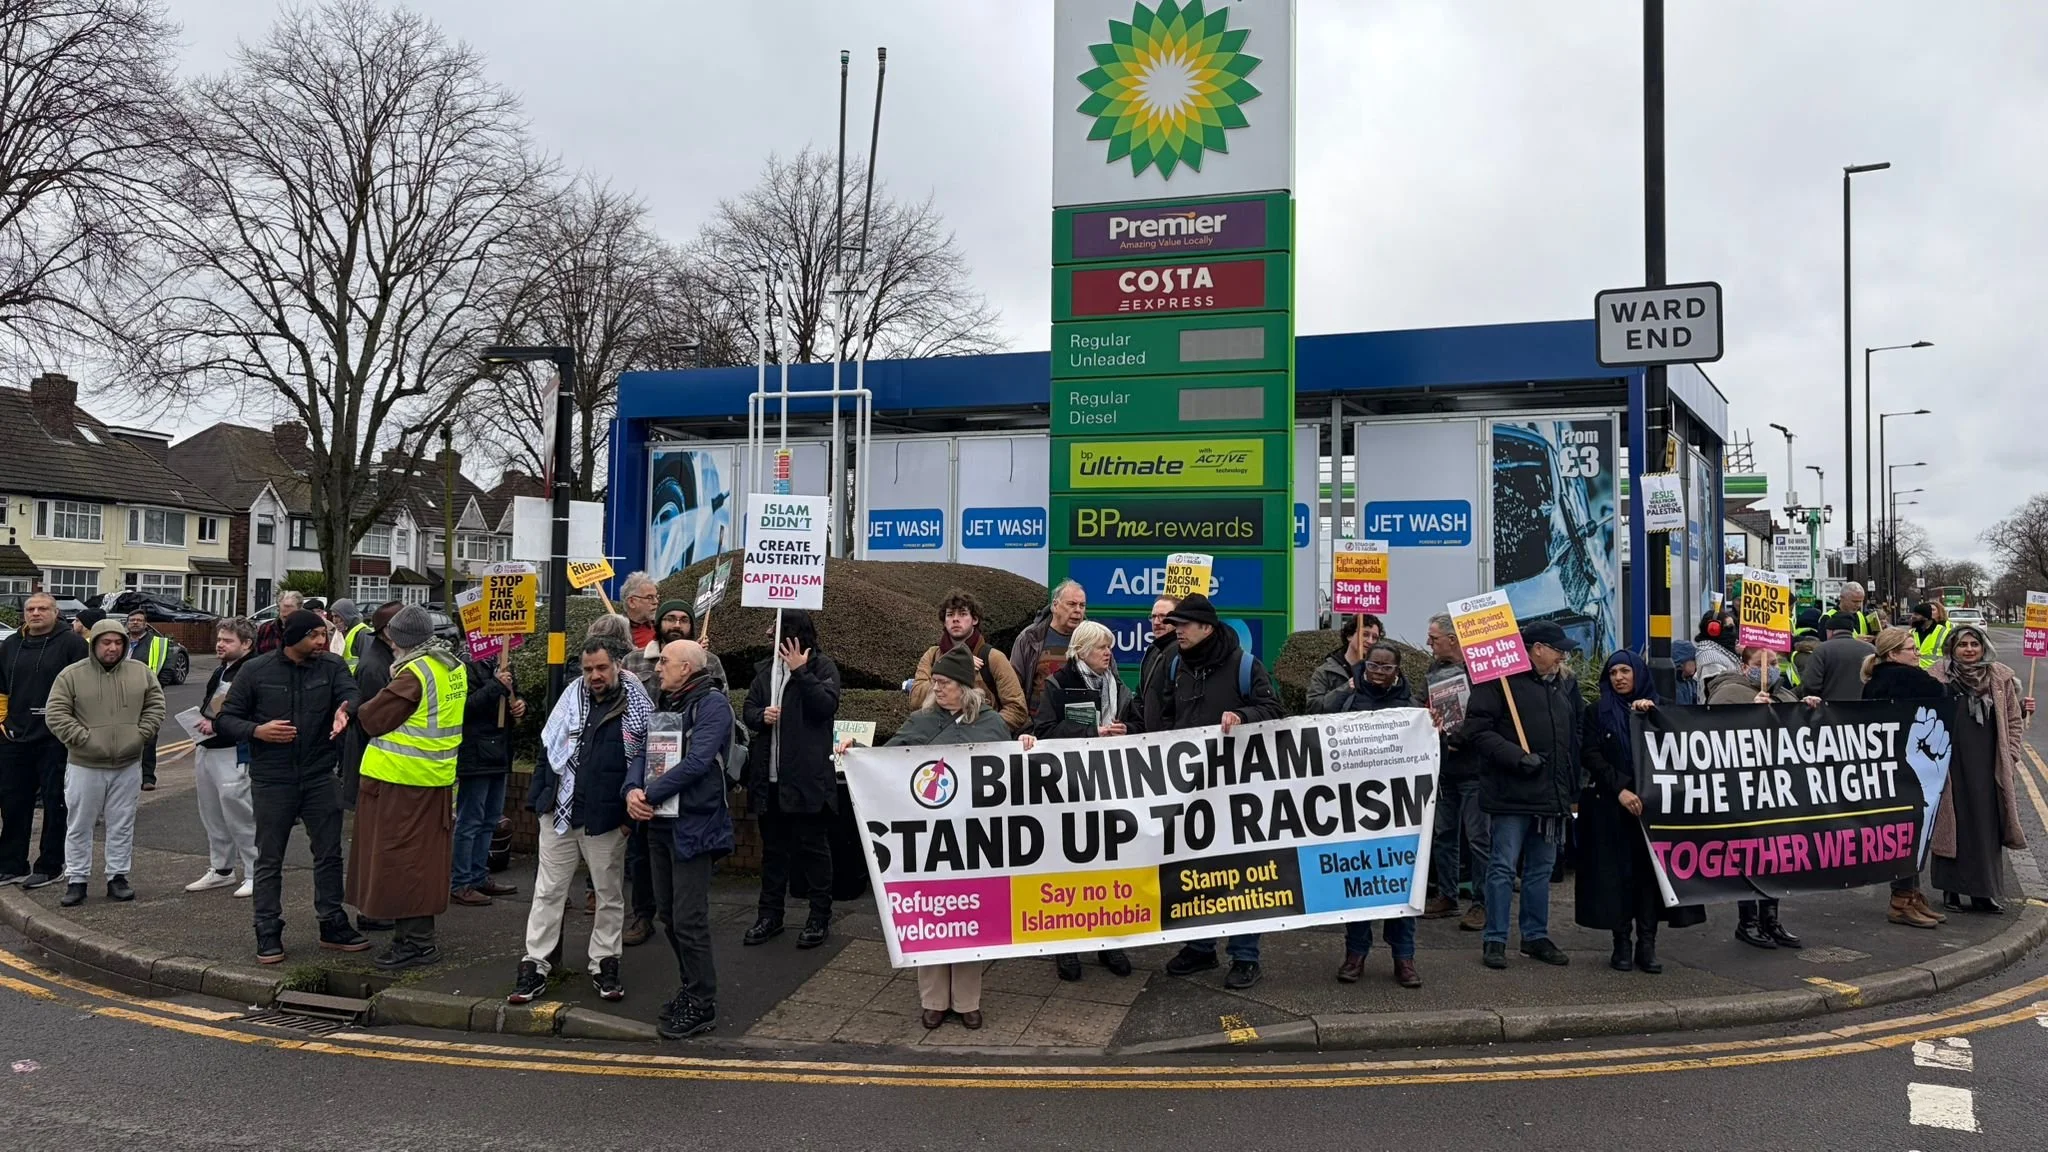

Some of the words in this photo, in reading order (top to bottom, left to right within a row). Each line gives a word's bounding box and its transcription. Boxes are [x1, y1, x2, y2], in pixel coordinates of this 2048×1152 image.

[1109, 212, 1227, 240] Premier
[1119, 240, 1156, 250] Amazing
[1158, 238, 1182, 247] Value
[1184, 235, 1214, 246] Locally
[1118, 267, 1214, 294] COSTA
[1132, 295, 1214, 310] EXPRESS
[1610, 297, 1706, 323] WARD
[1070, 333, 1131, 350] Regular
[1626, 326, 1692, 350] END
[1070, 351, 1146, 368] Unleaded
[1069, 392, 1131, 408] Regular
[1069, 410, 1118, 425] Diesel
[1561, 429, 1599, 444] From
[1081, 450, 1094, 460] bp
[1194, 453, 1248, 464] ACTIVE
[1560, 445, 1600, 478] £3
[1079, 455, 1184, 476] ultimate
[1215, 467, 1248, 475] technology
[1650, 490, 1675, 500] JESUS
[764, 503, 809, 516] ISLAM
[1646, 507, 1682, 517] PALESTINE
[760, 516, 812, 529] DIDN'T
[868, 521, 893, 537] JET
[896, 520, 940, 536] WASH
[966, 519, 993, 536] JET
[997, 519, 1043, 536] WASH
[1155, 516, 1254, 538] rewards
[1369, 513, 1404, 533] JET
[1409, 513, 1467, 533] WASH
[759, 540, 810, 552] CREATE
[745, 552, 824, 566] AUSTERITY.
[1336, 556, 1354, 565] Fight
[1355, 557, 1380, 565] against
[1168, 566, 1179, 575] NO
[1182, 566, 1192, 576] TO
[1336, 566, 1382, 574] Islamophobia
[490, 575, 523, 587] STOP
[744, 573, 822, 585] CAPITALISM
[1106, 567, 1220, 596] AdBe
[1168, 576, 1200, 587] RACISM,
[1336, 581, 1361, 594] Stop
[1363, 582, 1382, 593] the
[490, 587, 514, 599] THE
[1166, 585, 1177, 594] NO
[1179, 585, 1190, 595] TO
[1743, 582, 1761, 597] NO
[1765, 585, 1778, 600] TO
[489, 599, 513, 610] FAR
[1336, 593, 1352, 605] far
[1355, 594, 1380, 607] right
[1743, 596, 1786, 615] RACIST
[463, 606, 479, 617] Fight
[489, 609, 527, 622] RIGHT
[1743, 608, 1771, 625] UKIP
[1457, 618, 1476, 630] Fight
[1477, 611, 1505, 625] against
[1460, 620, 1510, 639] Islamophobia
[472, 641, 488, 652] far
[1466, 645, 1494, 659] Stop
[1496, 639, 1516, 652] the
[1471, 660, 1488, 673] far
[1491, 651, 1521, 668] right
[1339, 732, 1399, 746] sutrbirmingham
[1644, 728, 1774, 771] WOMEN
[1776, 722, 1900, 765] AGAINST
[972, 726, 1324, 809] BIRMINGHAM
[1342, 752, 1431, 770] standuptoracism.org.uk
[1652, 773, 1730, 815] THE
[1738, 769, 1799, 811] FAR
[1805, 761, 1898, 805] RIGHT
[866, 814, 1045, 874] STAND
[1061, 808, 1139, 864] UP
[1150, 798, 1216, 856] TO
[1229, 773, 1434, 846] RACISM
[1650, 833, 1813, 881] TOGETHER
[1813, 829, 1857, 869] WE
[1861, 822, 1915, 865] RISE!
[1319, 850, 1373, 874] Black
[1180, 866, 1240, 892] Stamp
[1246, 860, 1278, 883] out
[1040, 883, 1076, 907] Say
[1083, 885, 1107, 901] no
[1113, 880, 1133, 899] to
[1344, 875, 1408, 899] Matter
[887, 889, 981, 917] Refugees
[1170, 887, 1294, 919] antisemitism
[1022, 903, 1151, 932] Islamophobia
[894, 917, 980, 942] welcome
